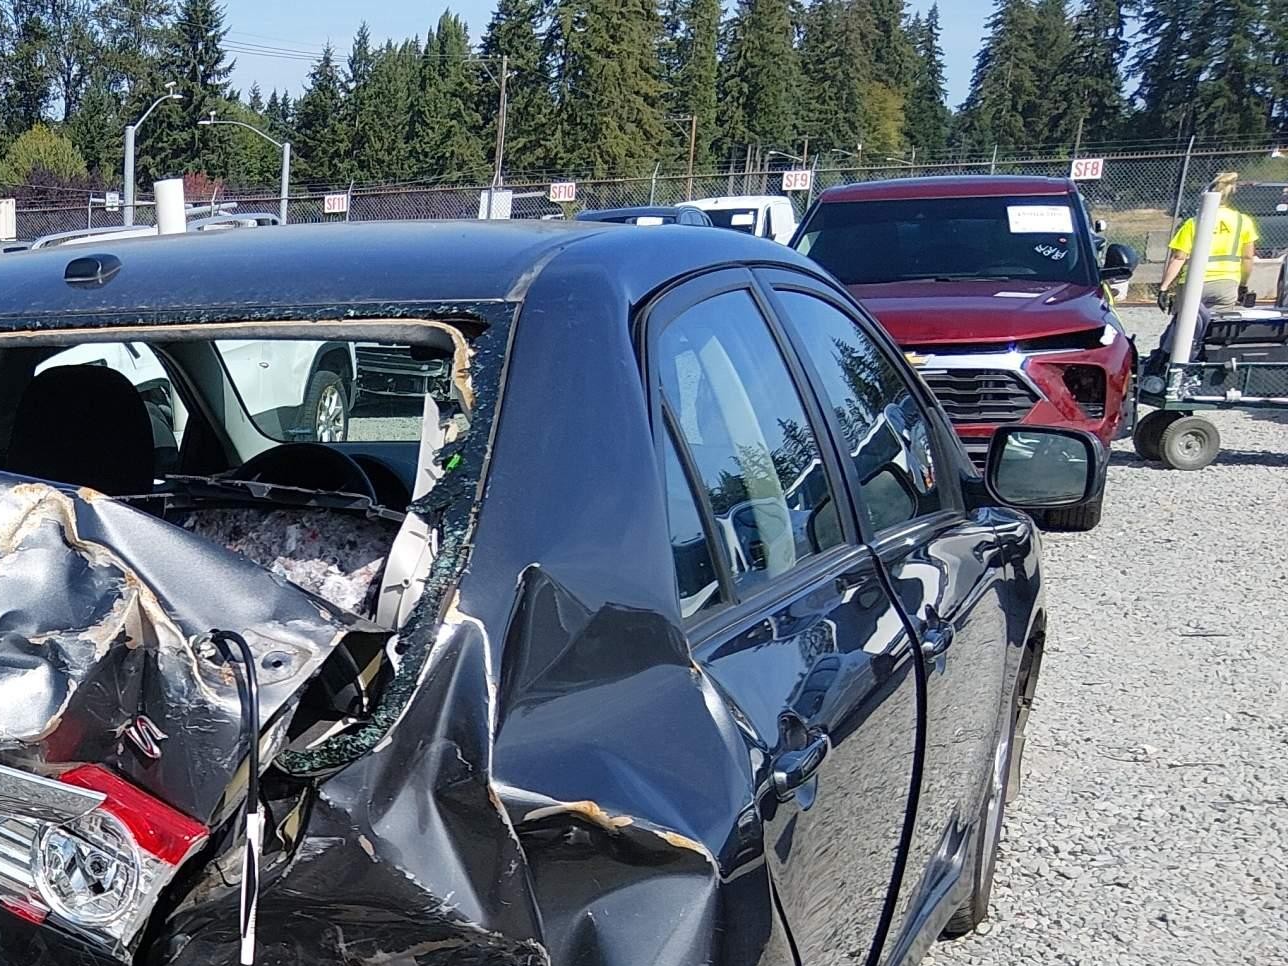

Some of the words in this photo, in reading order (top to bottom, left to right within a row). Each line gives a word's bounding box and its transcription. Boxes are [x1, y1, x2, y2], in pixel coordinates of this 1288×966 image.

[1074, 161, 1099, 177] SF8
[785, 172, 808, 188] SF9
[551, 185, 574, 199] SF10
[326, 196, 345, 211] SF11
